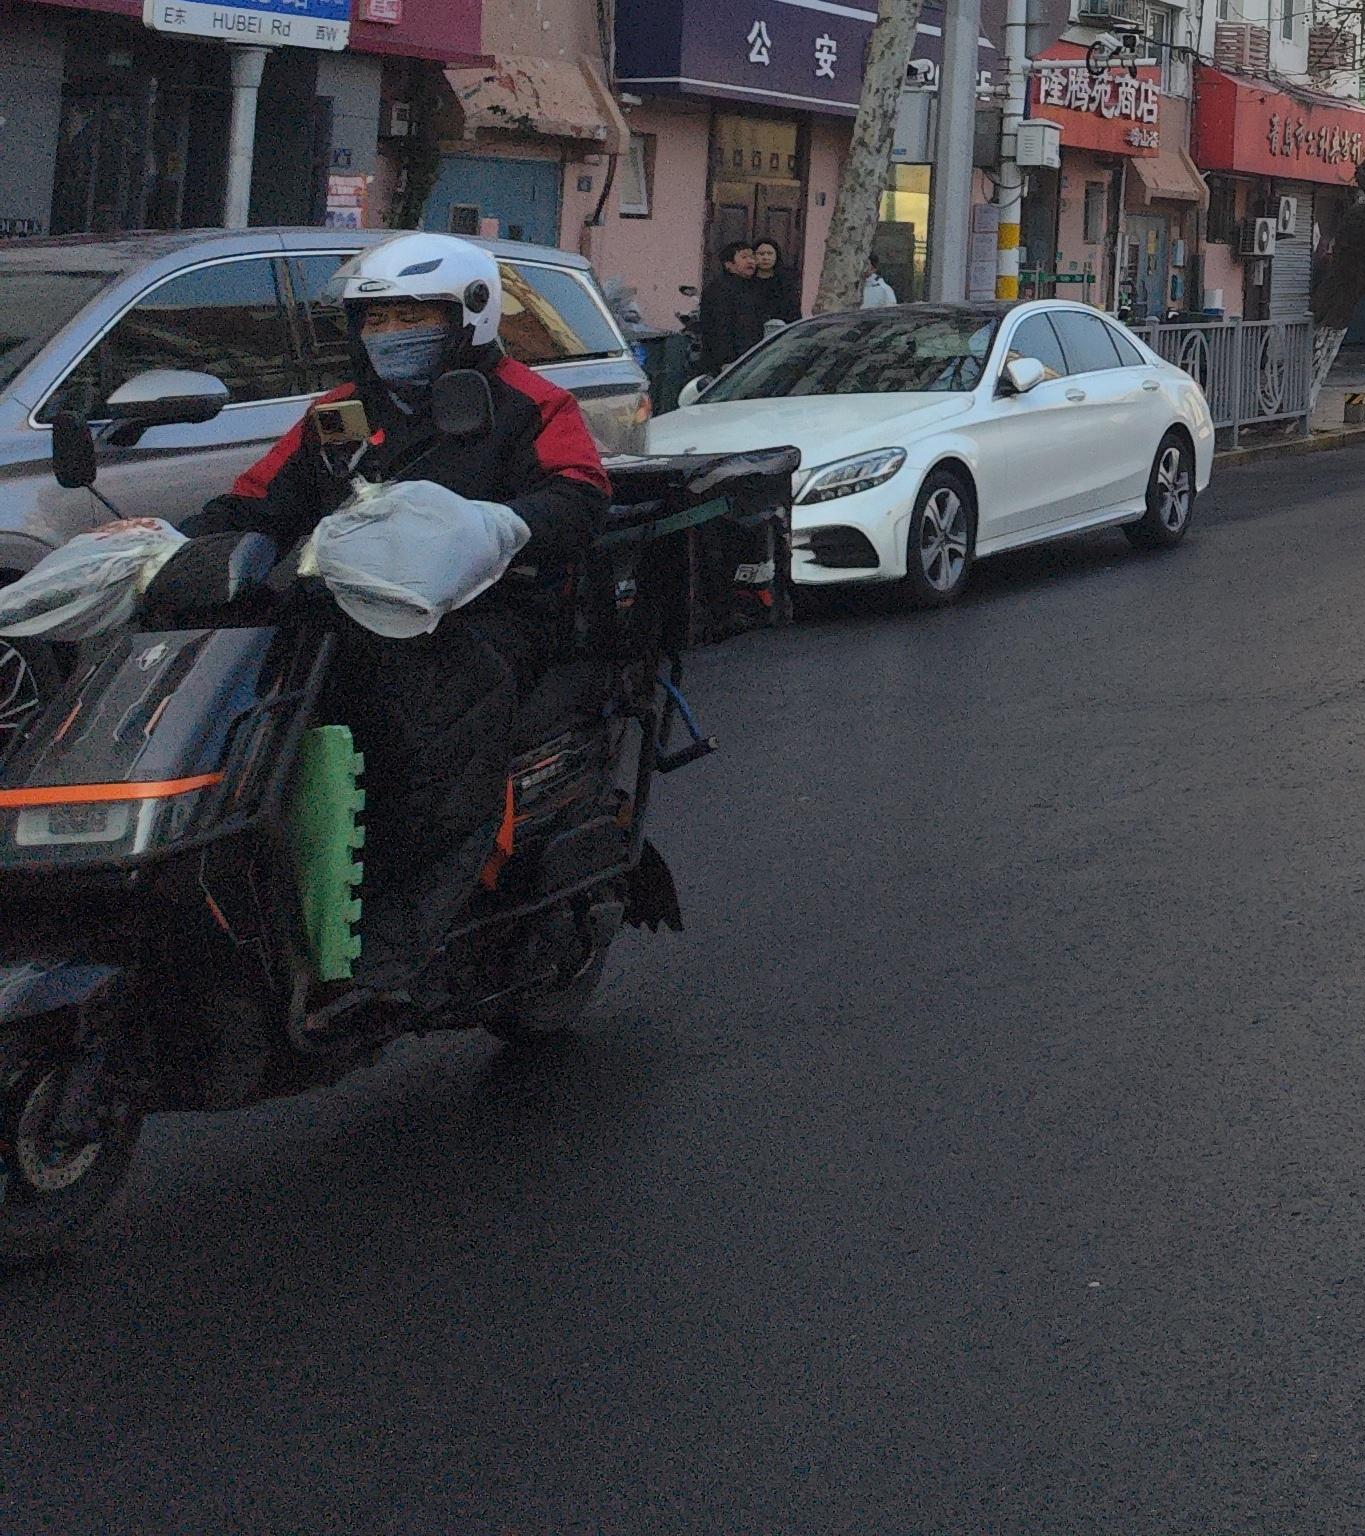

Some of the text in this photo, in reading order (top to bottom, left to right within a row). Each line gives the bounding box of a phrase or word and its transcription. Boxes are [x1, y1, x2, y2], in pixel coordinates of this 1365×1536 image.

[213, 12, 262, 34] HUBEI
[271, 18, 291, 37] Rd
[1040, 68, 1161, 124] 隆腾苑商店
